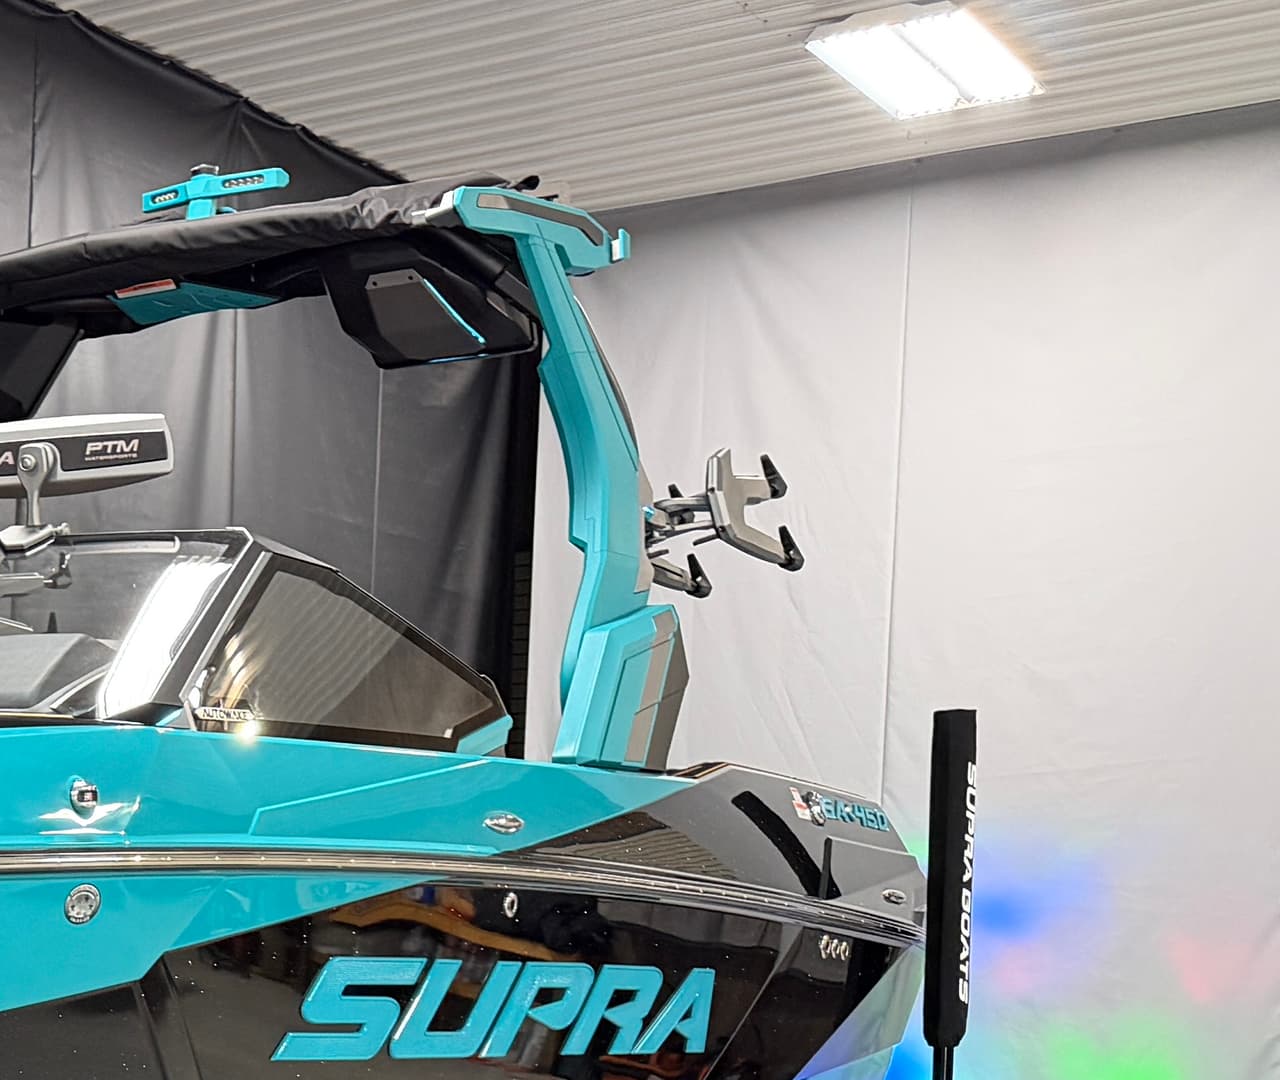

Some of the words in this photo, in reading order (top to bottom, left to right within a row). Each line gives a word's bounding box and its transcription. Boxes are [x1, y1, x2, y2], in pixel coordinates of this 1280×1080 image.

[85, 439, 140, 455] PTM
[962, 761, 977, 882] SUPRA
[958, 887, 972, 1004] BOATS
[270, 956, 716, 1061] SUPRA
